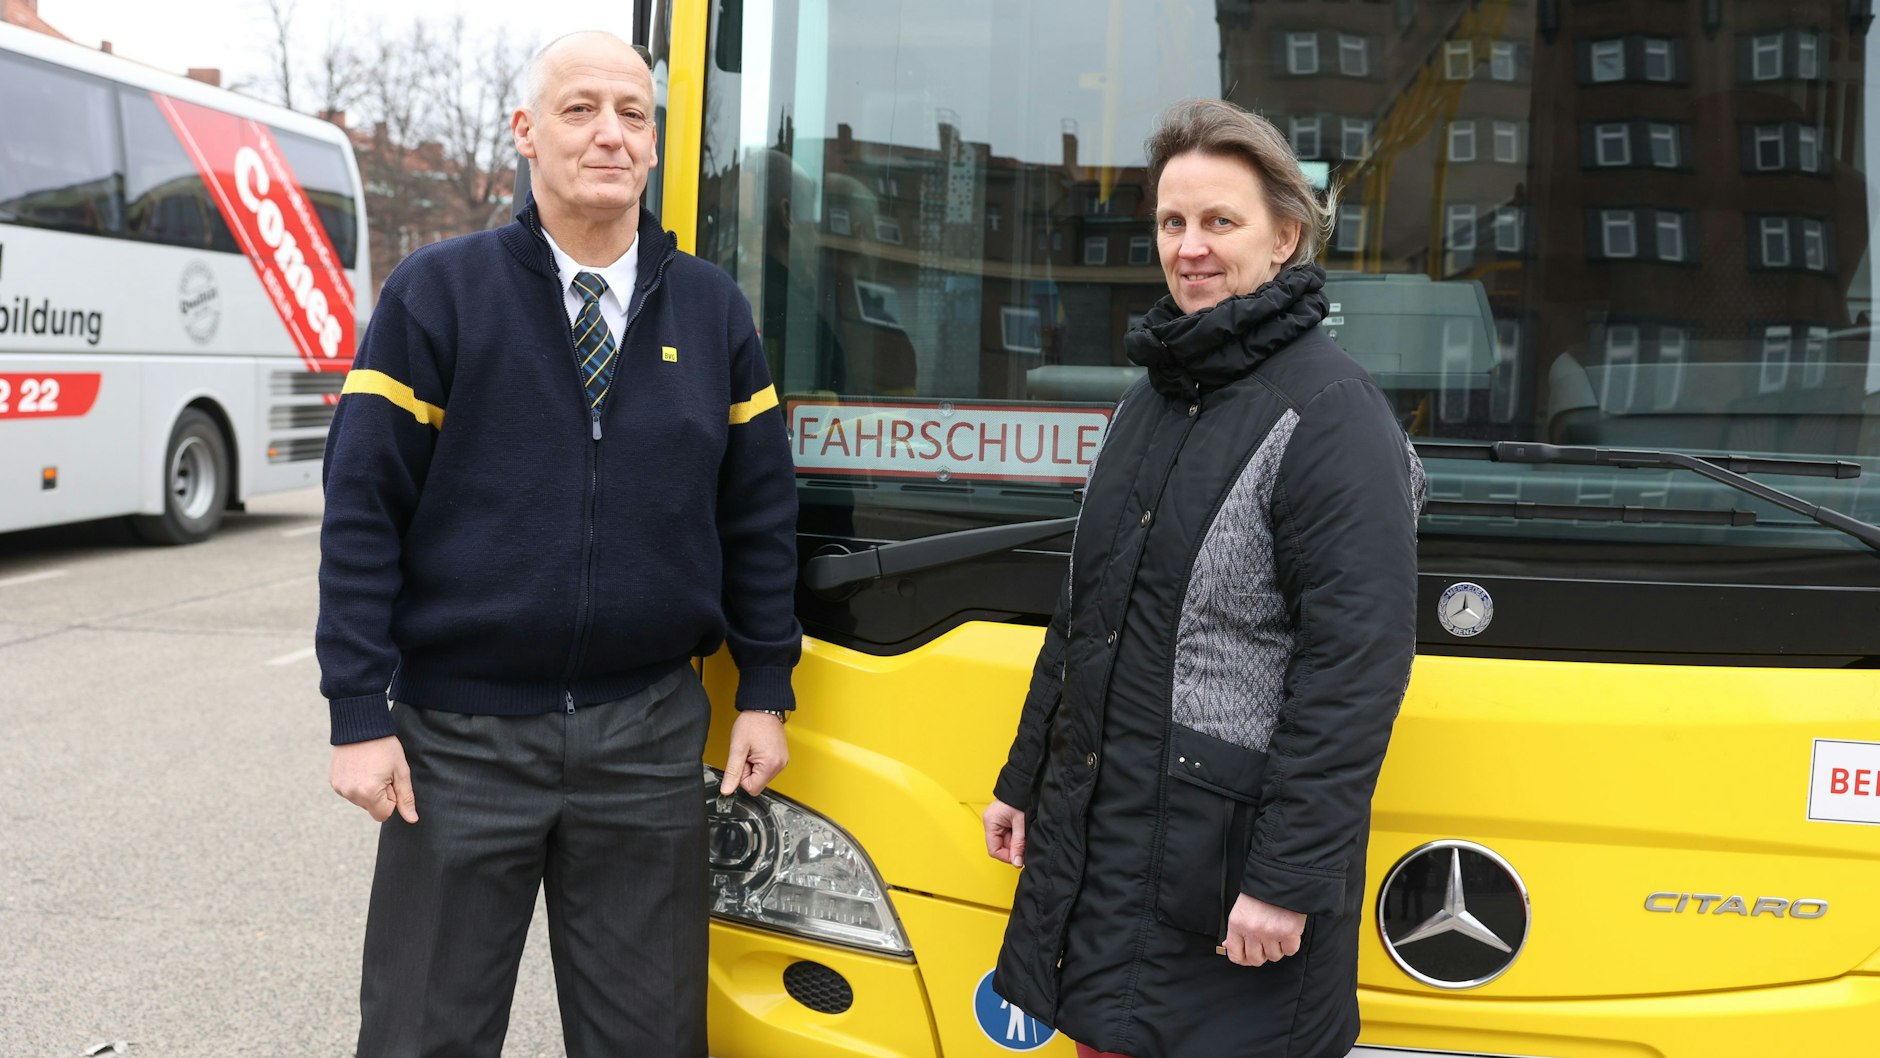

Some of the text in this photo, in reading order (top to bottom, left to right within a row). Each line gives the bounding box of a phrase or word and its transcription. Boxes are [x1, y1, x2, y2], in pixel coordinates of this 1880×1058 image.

[234, 146, 342, 358] Comes
[17, 378, 60, 413] 22
[799, 417, 1100, 465] FAHRSCHULE
[1446, 585, 1487, 600] MERCEDES
[1452, 627, 1475, 636] BENZ
[1830, 767, 1880, 797] BE
[1644, 891, 1829, 919] CITARO
